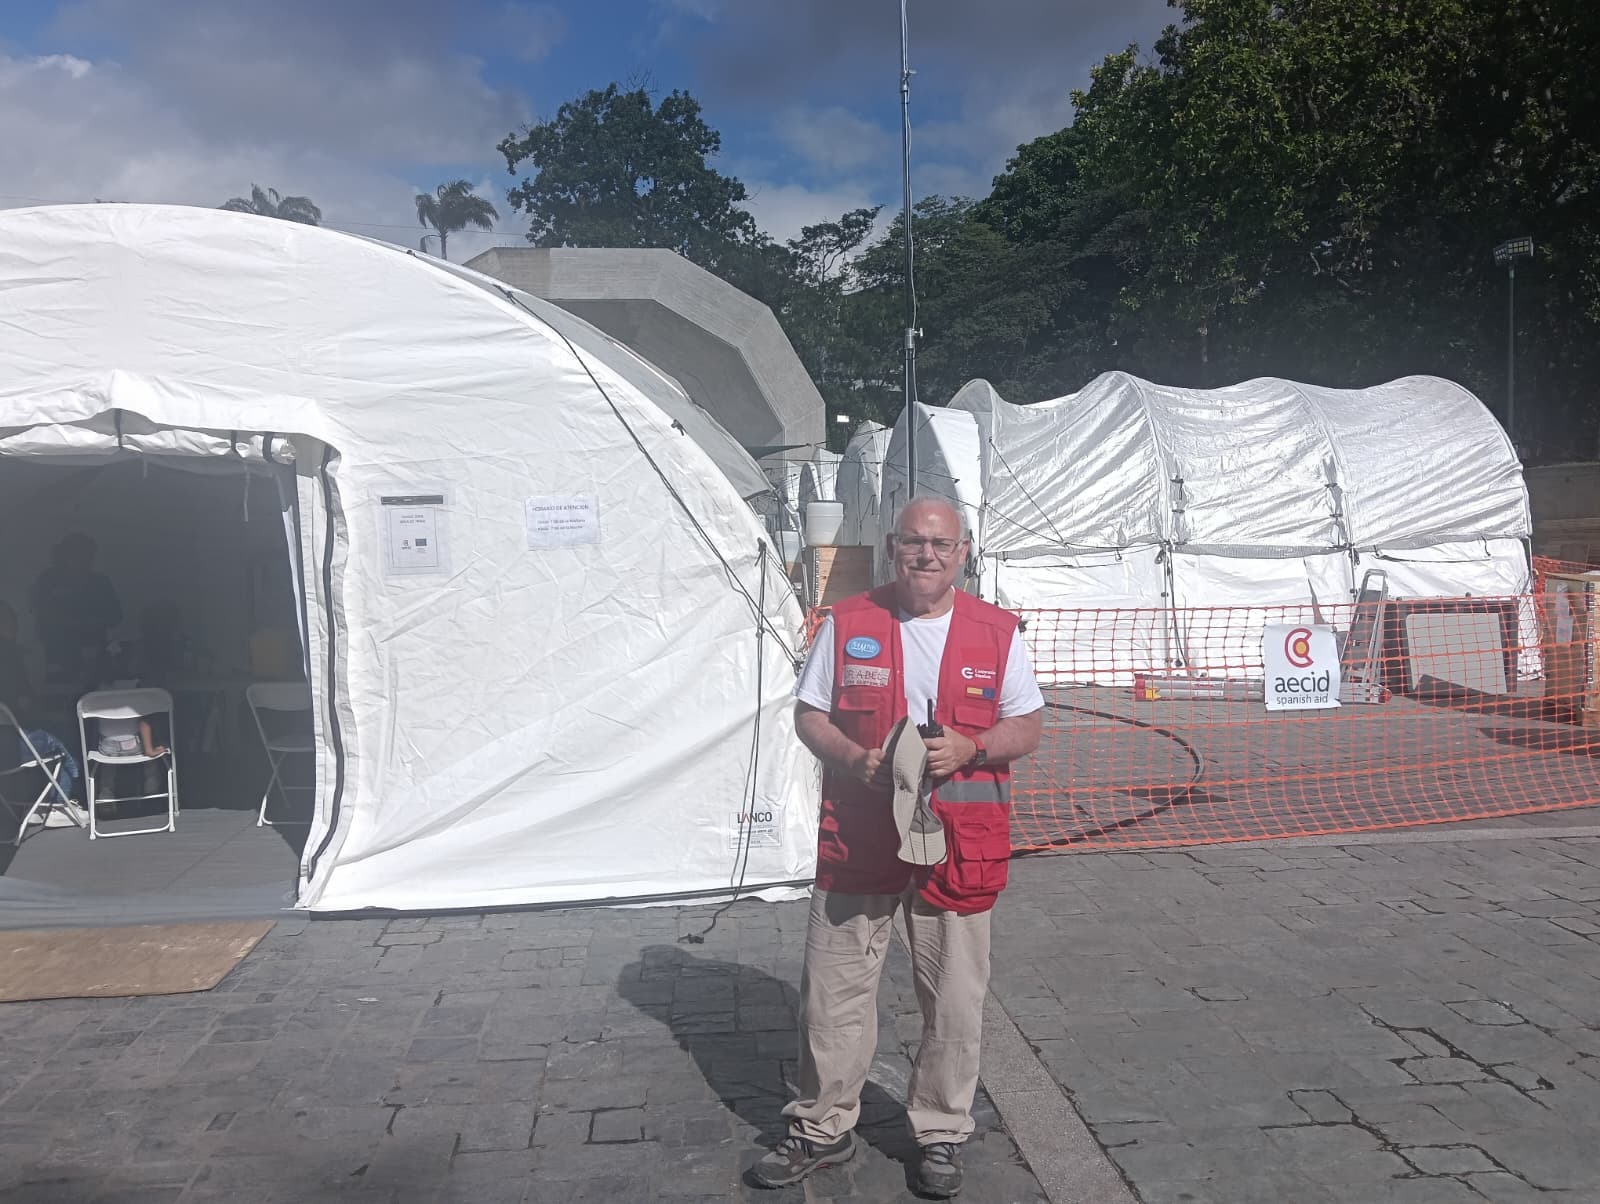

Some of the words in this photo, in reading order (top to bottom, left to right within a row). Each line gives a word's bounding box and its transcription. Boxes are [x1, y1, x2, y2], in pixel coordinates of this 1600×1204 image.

[1274, 670, 1330, 693] aecid
[1276, 694, 1312, 706] spanish
[1314, 693, 1328, 704] aid
[737, 811, 773, 824] LANCO
